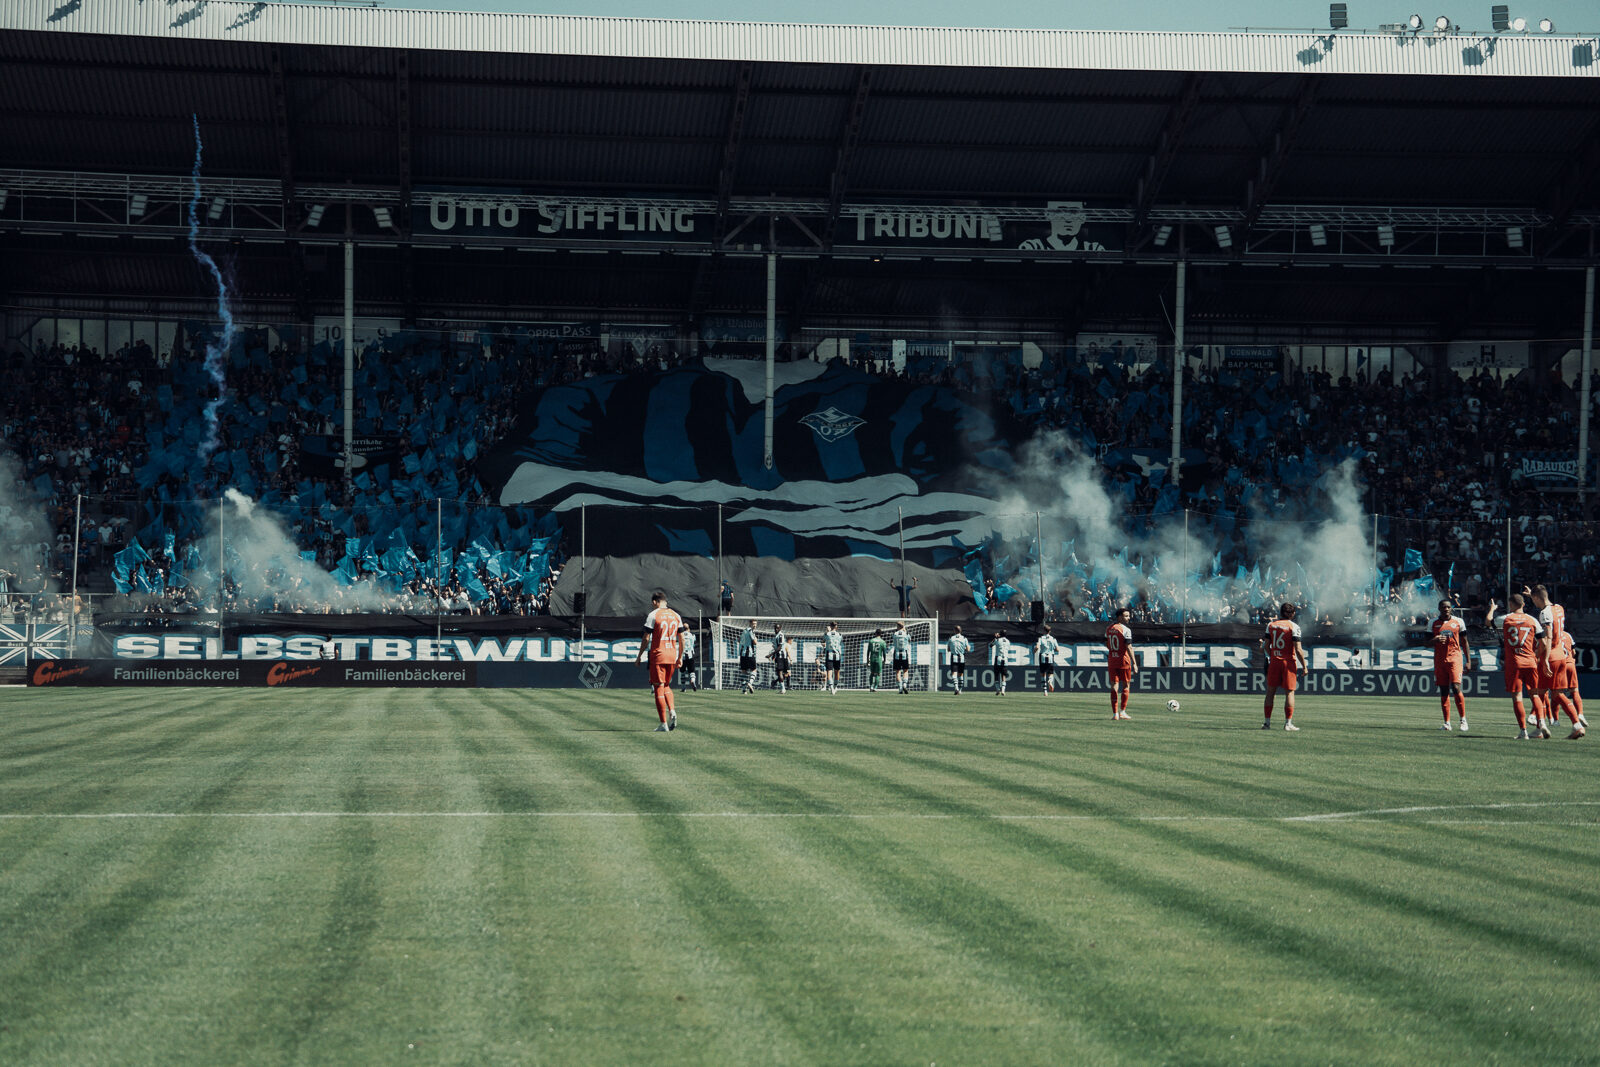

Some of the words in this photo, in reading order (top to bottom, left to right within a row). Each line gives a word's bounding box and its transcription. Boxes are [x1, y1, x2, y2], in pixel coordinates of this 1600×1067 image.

[537, 198, 696, 234] SIFFLING
[1230, 348, 1273, 357] ODENWALD
[1480, 345, 1496, 363] H
[660, 620, 677, 641] 22
[1272, 630, 1286, 649] 16
[1507, 626, 1532, 647] 37
[872, 642, 881, 652] 12
[1108, 634, 1120, 651] 10
[114, 635, 688, 663] SELBSTBEWUSS
[986, 644, 1249, 669] BRETER
[114, 668, 240, 680] Familienbäckerei
[344, 668, 466, 681] Familienbäckerei
[1182, 672, 1267, 691] UNTER
